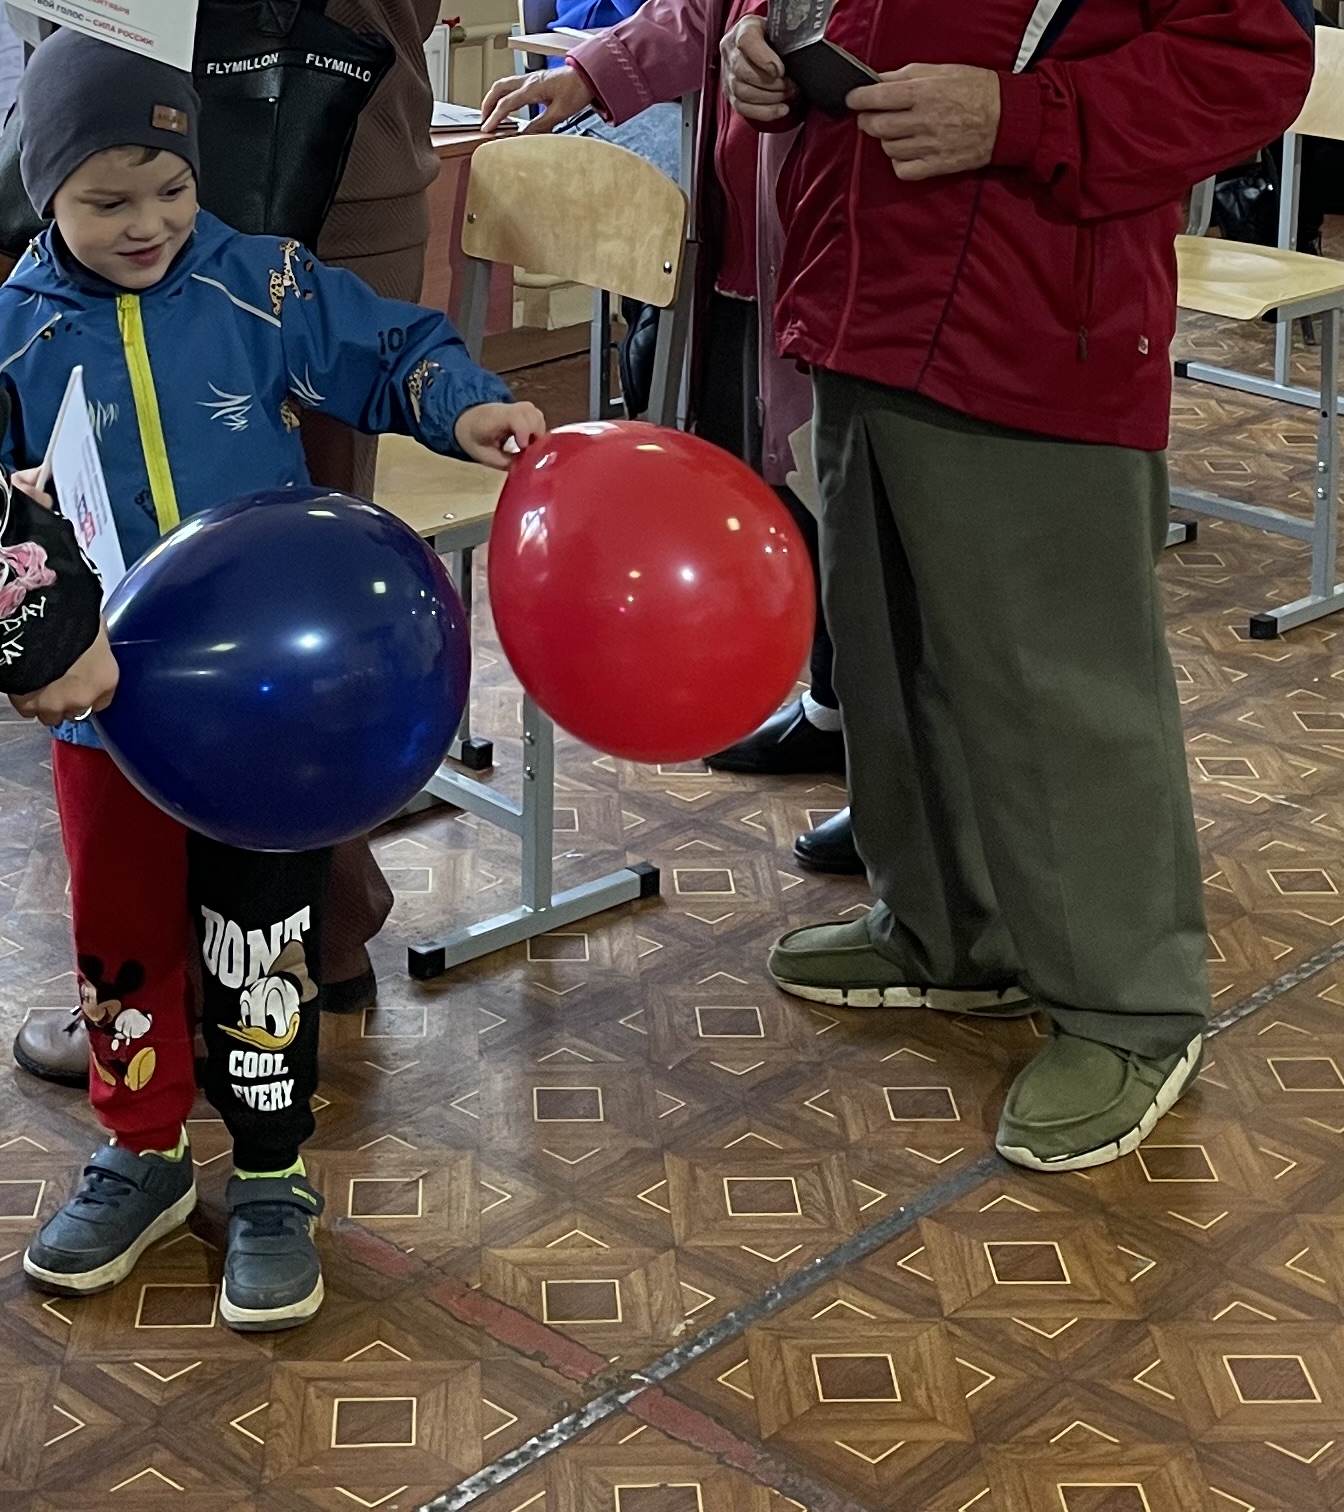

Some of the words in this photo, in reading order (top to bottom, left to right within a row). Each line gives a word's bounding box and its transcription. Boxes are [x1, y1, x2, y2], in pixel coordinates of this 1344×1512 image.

[56, 4, 85, 22] ГОЛОС
[206, 52, 280, 75] FLYMILLON
[228, 1050, 289, 1078] COOL
[231, 1079, 295, 1112] EVERY
